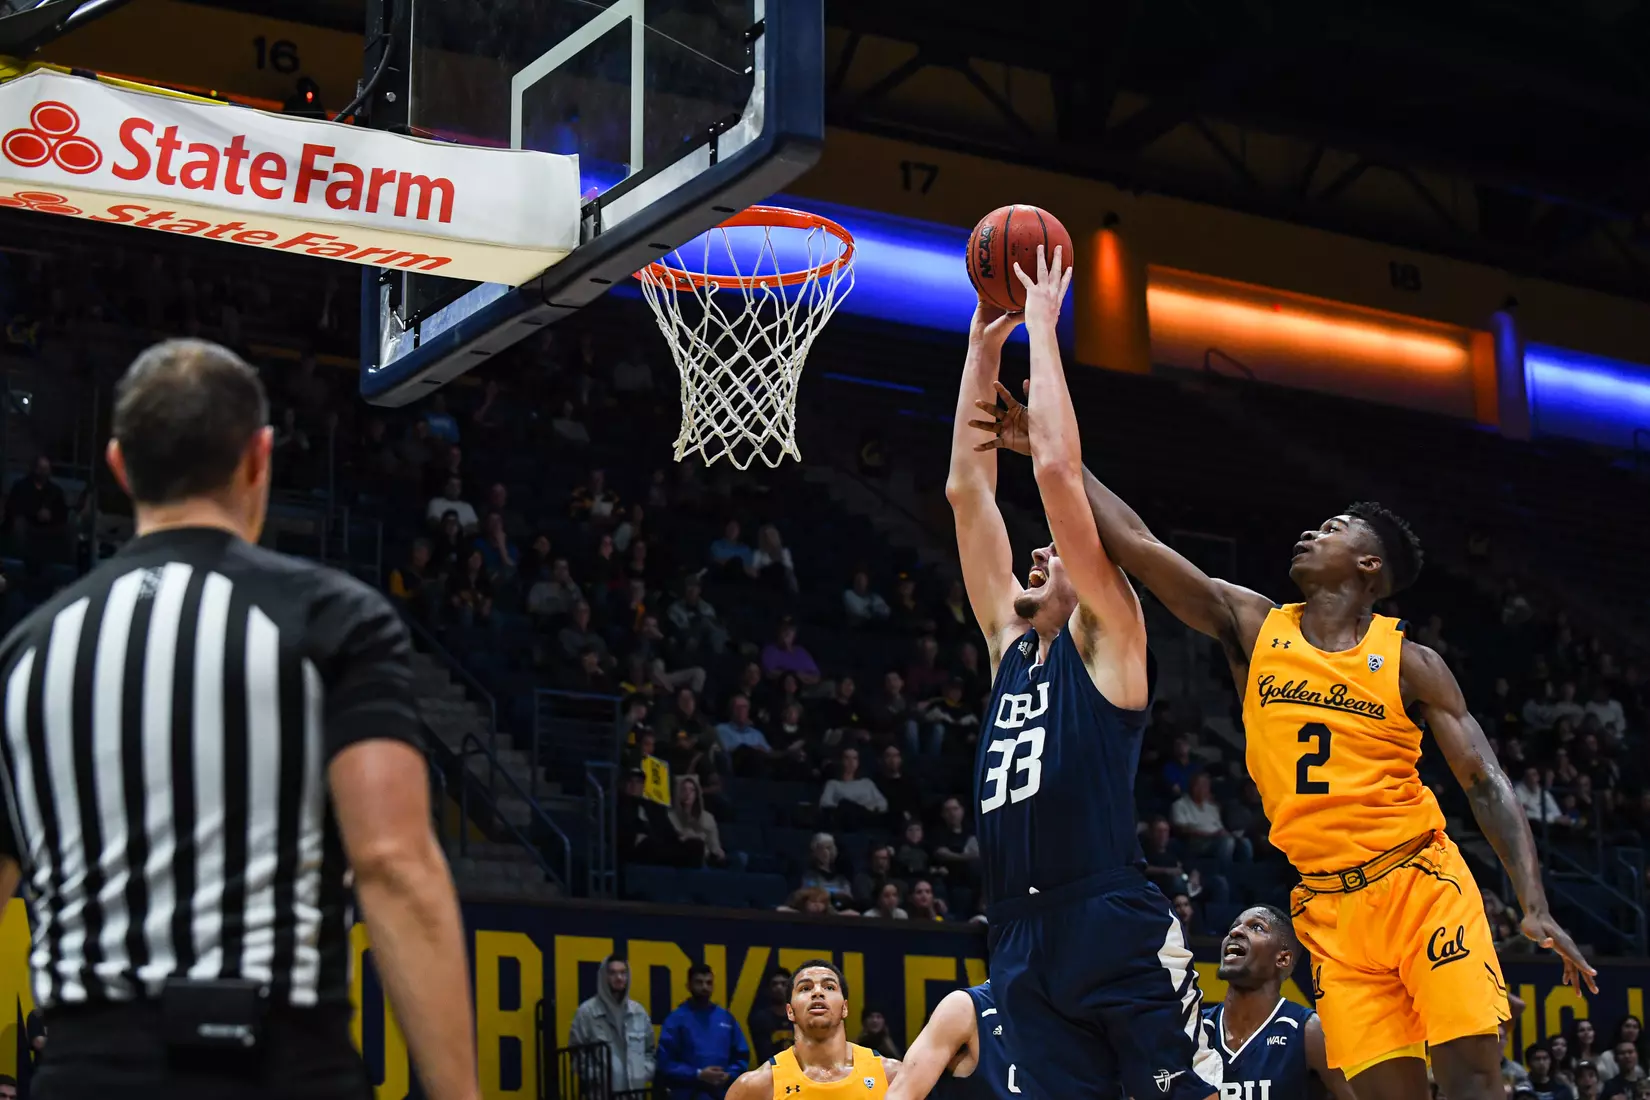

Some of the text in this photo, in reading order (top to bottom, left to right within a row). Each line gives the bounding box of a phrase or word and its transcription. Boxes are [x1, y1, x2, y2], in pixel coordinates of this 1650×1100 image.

[253, 36, 299, 74] 16
[900, 160, 939, 195] 17
[979, 224, 994, 279] NCAA
[1258, 675, 1387, 717] Golden Bears
[981, 726, 1046, 814] 33
[1296, 722, 1332, 794] 2
[1427, 925, 1471, 971] Cal
[1266, 1035, 1288, 1046] WAC
